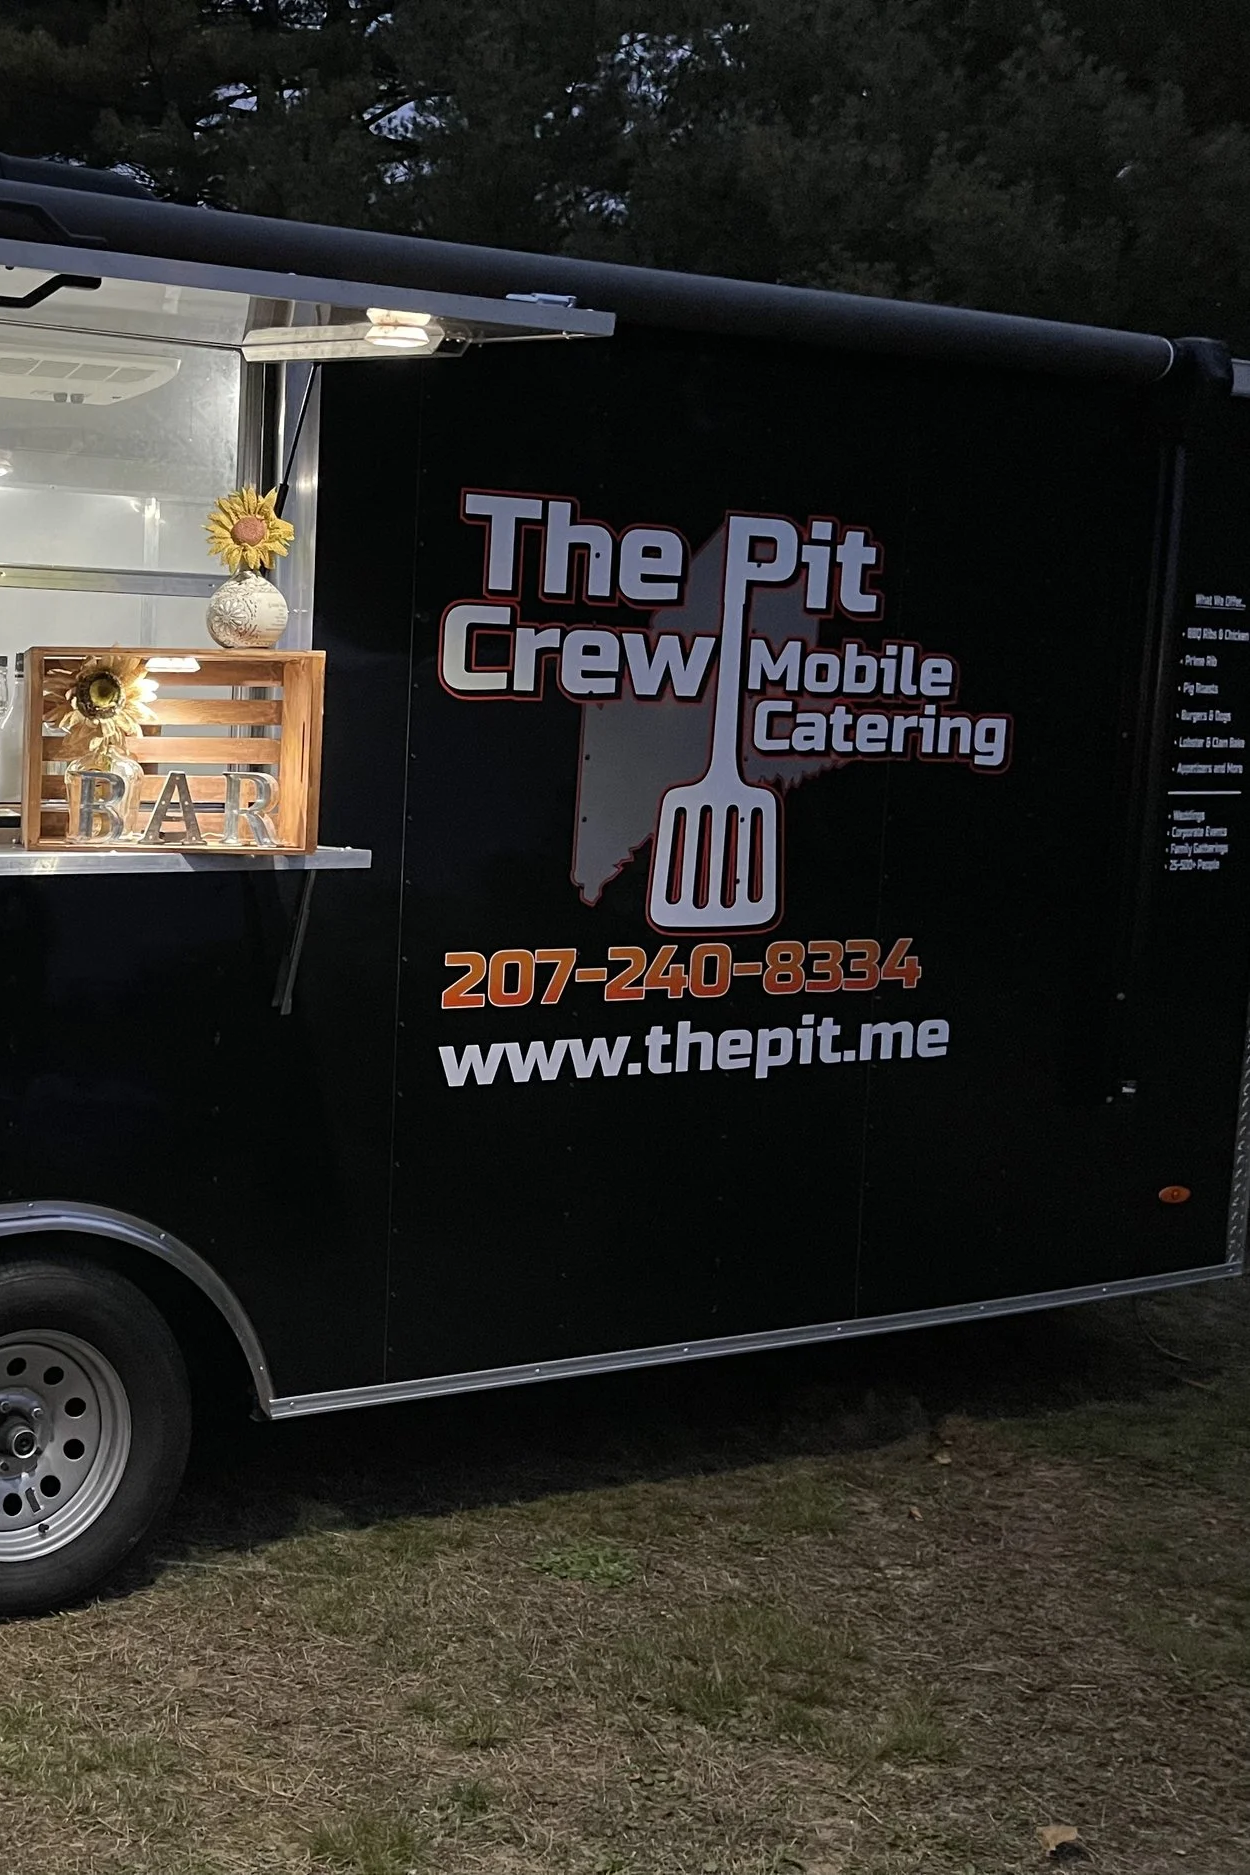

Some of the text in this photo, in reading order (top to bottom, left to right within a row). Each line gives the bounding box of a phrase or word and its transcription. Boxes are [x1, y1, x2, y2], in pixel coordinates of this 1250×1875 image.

[464, 492, 877, 612] The Pit
[440, 603, 716, 698] Crew
[747, 638, 953, 697] Mobile
[753, 700, 1007, 767] Catering
[65, 770, 285, 848] BAR
[441, 938, 922, 1009] 207-240-8334
[438, 1014, 950, 1087] www.thepit.me
